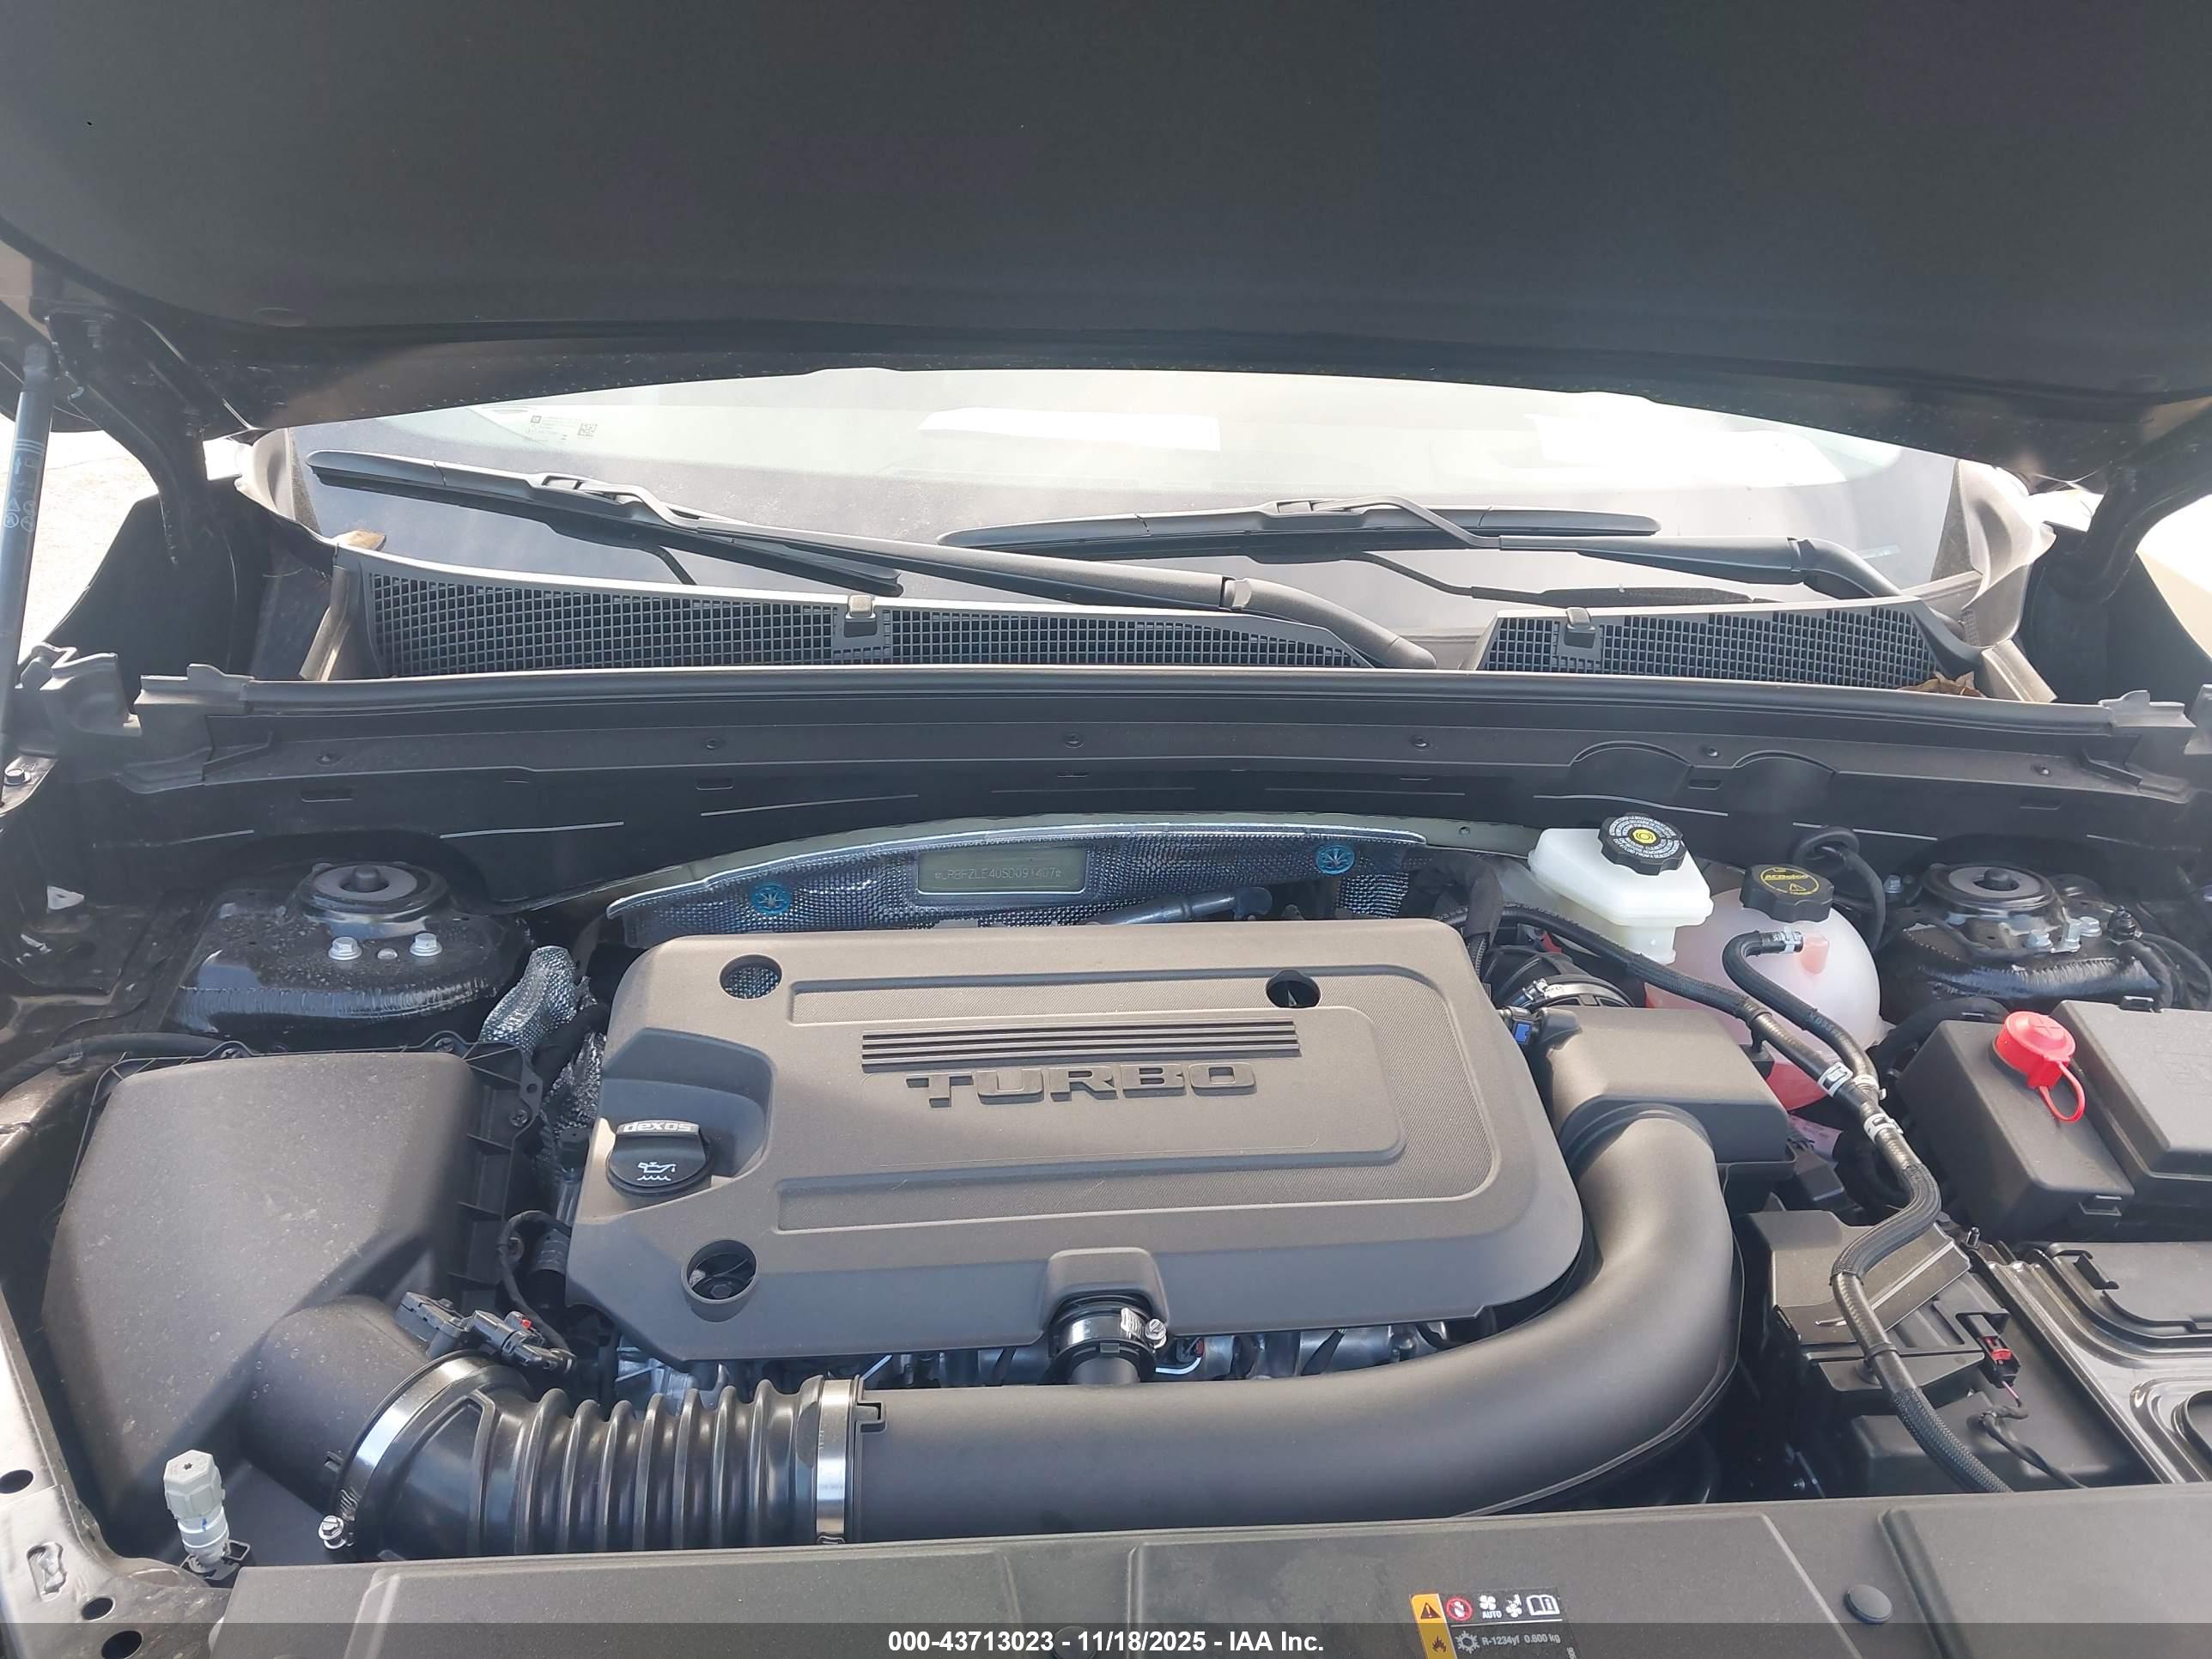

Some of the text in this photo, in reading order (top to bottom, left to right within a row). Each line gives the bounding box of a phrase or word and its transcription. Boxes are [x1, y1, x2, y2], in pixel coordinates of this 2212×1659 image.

[905, 1062, 1257, 1108] TURBO
[623, 1121, 691, 1133] dexos
[1482, 1610, 1502, 1619] AUTO
[1481, 1635, 1520, 1645] R-1234yf
[1548, 1633, 1561, 1644] kg
